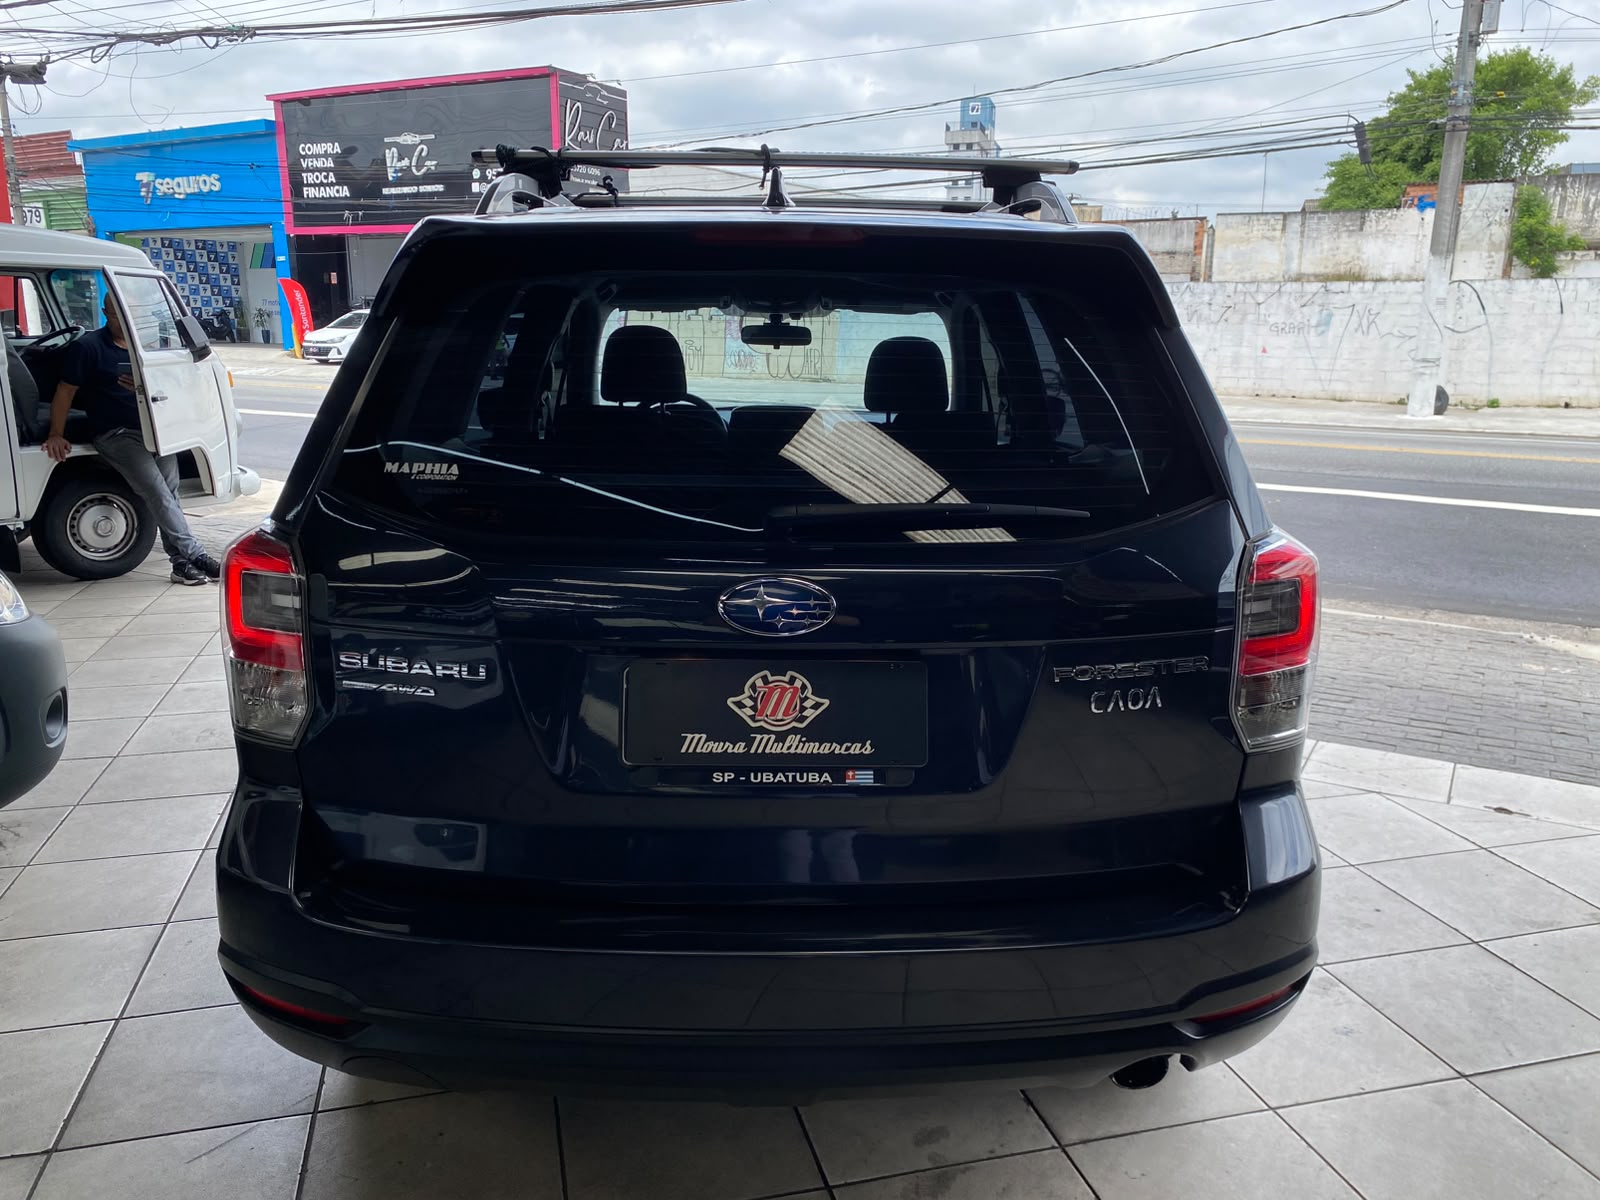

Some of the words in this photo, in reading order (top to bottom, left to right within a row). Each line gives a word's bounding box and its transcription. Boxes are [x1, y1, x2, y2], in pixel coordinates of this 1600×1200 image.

[299, 142, 342, 155] COMPRA
[300, 157, 335, 169] VENDA
[155, 173, 222, 199] seguros
[302, 172, 336, 184] TROCA
[303, 186, 350, 198] FINANCIA
[293, 289, 310, 330] Santander
[384, 462, 459, 475] MAPHIA
[339, 652, 486, 680] SUBARU
[1053, 655, 1209, 683] FORESTER
[1090, 686, 1163, 714] CAOA
[680, 733, 748, 755] Moura
[749, 733, 875, 756] Multimarcas
[712, 772, 735, 784] SP
[750, 771, 833, 784] UBATUBA
